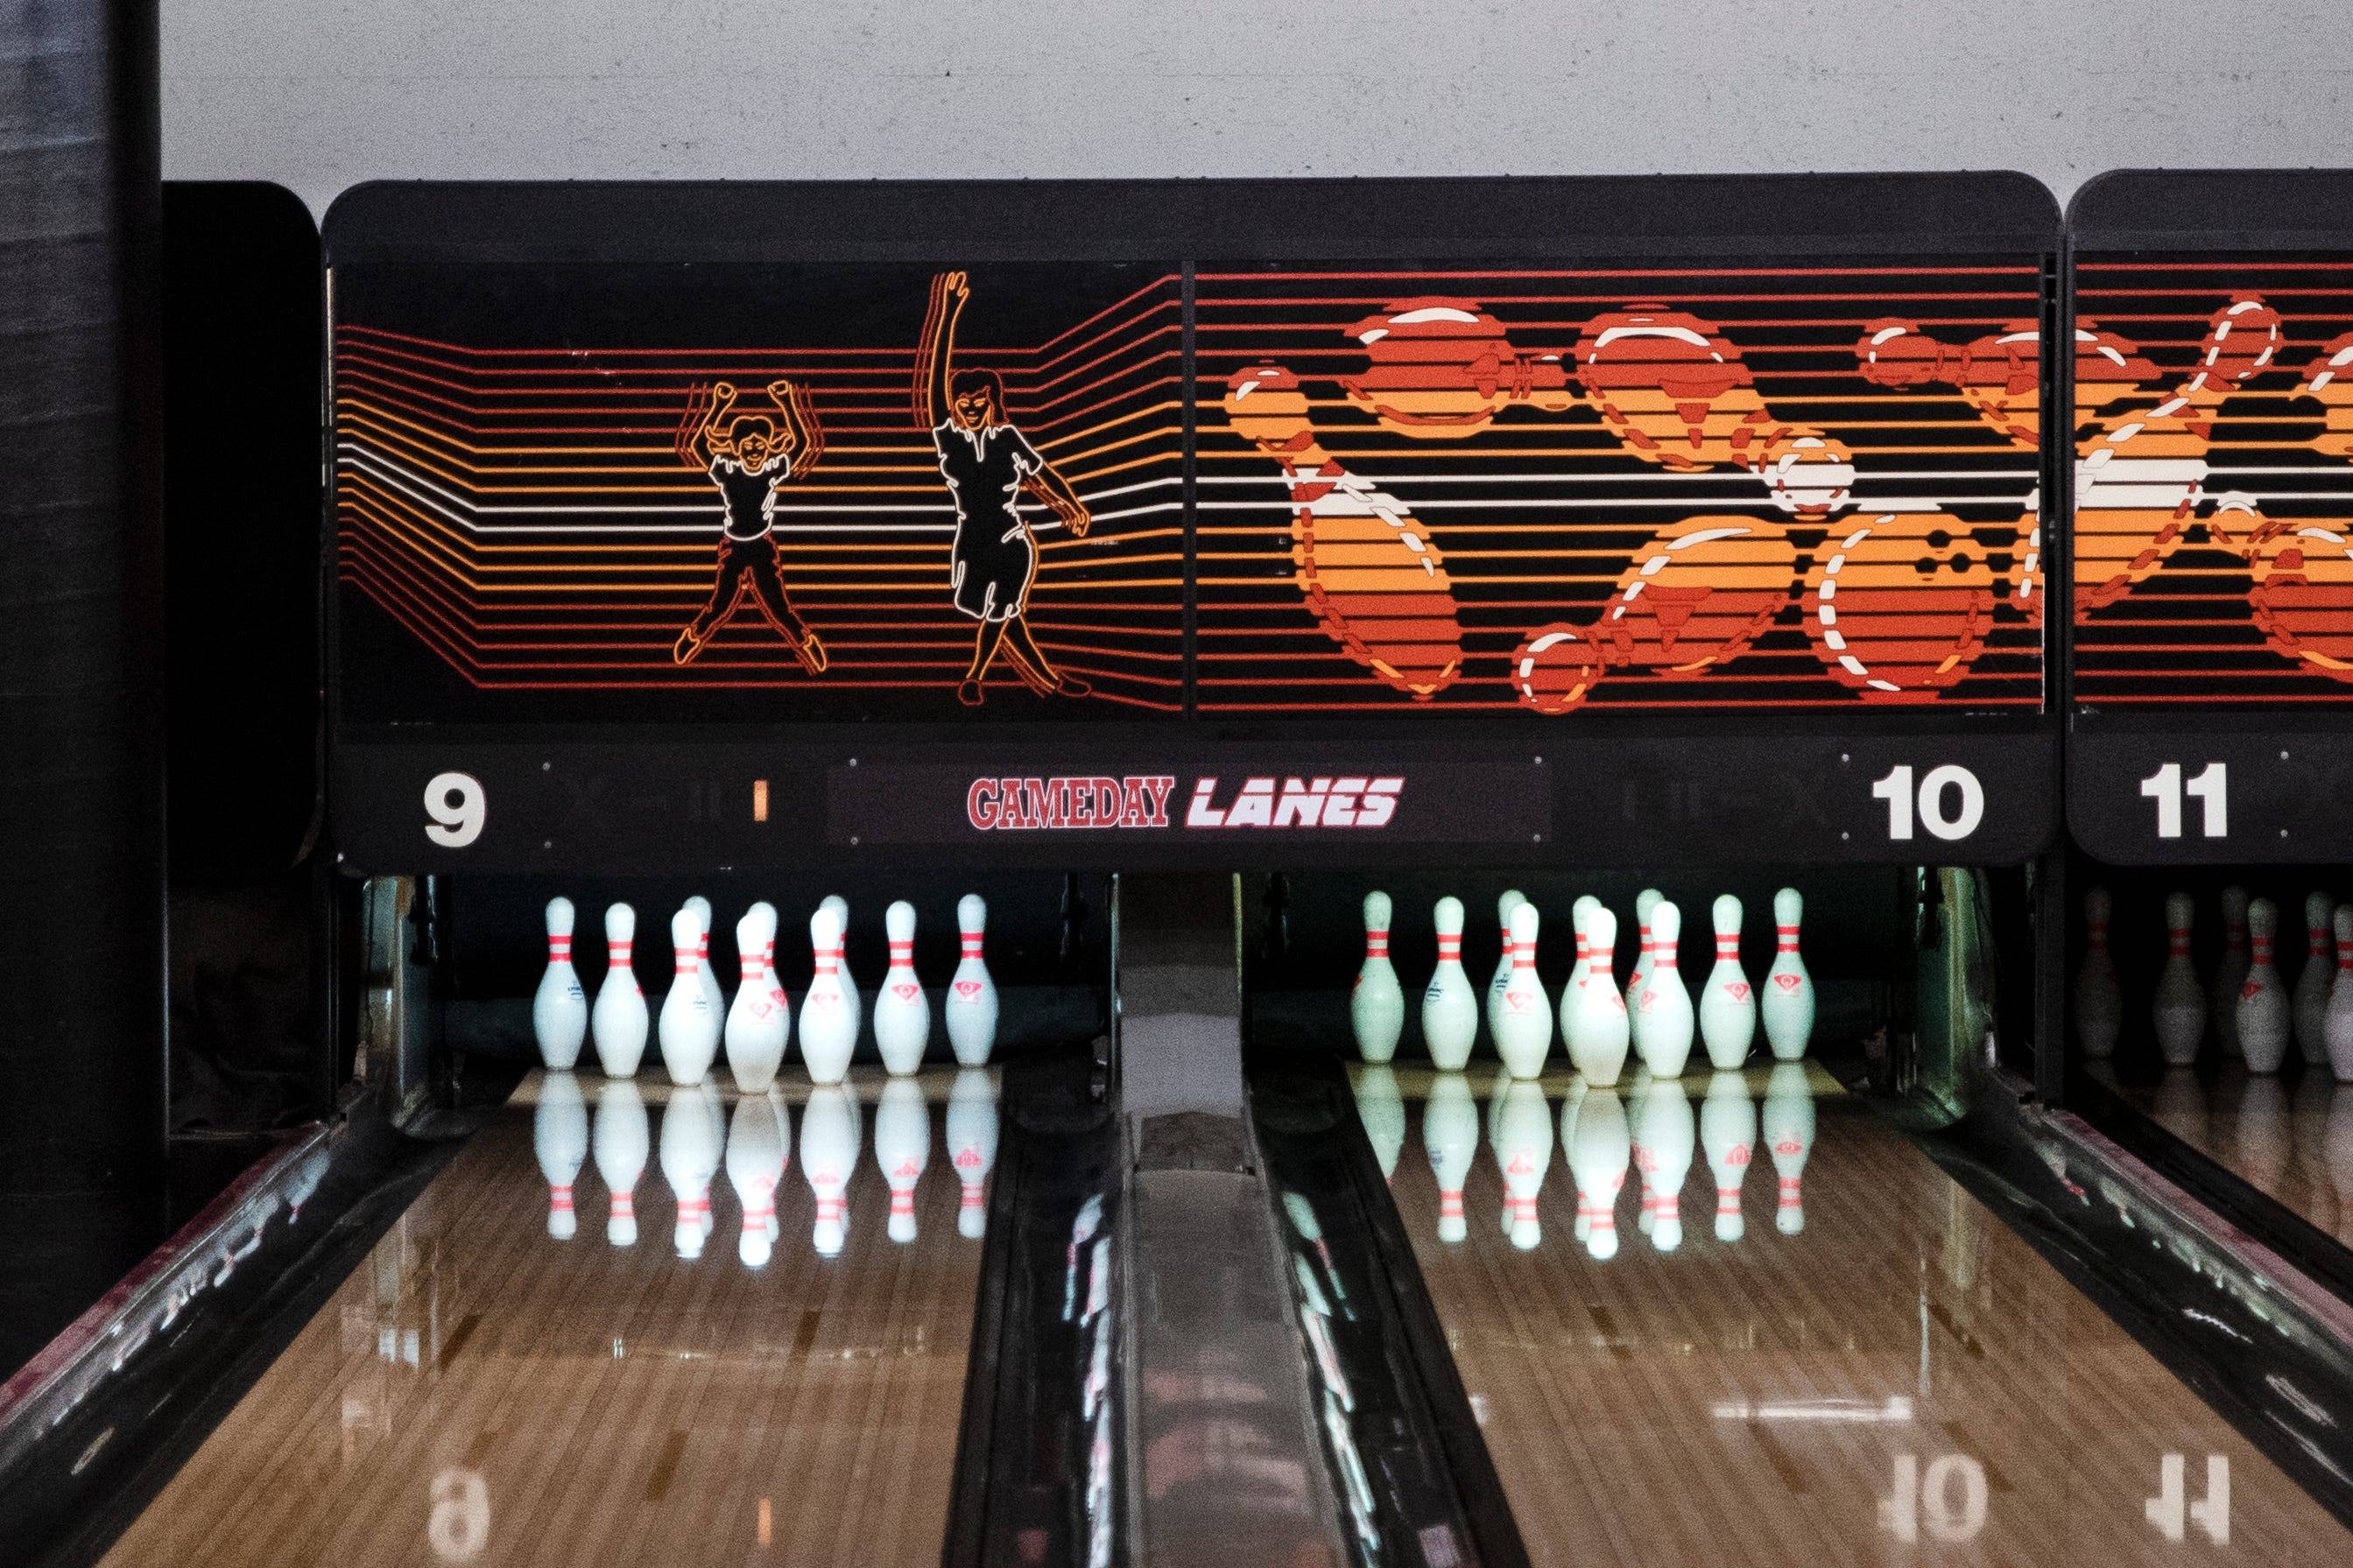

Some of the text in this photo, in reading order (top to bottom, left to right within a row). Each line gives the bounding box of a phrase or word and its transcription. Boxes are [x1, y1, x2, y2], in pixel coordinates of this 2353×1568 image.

[425, 773, 486, 847] 9
[967, 776, 1405, 831] GAMEDAY LANES
[1872, 764, 1984, 840] 10
[2140, 762, 2228, 838] 11
